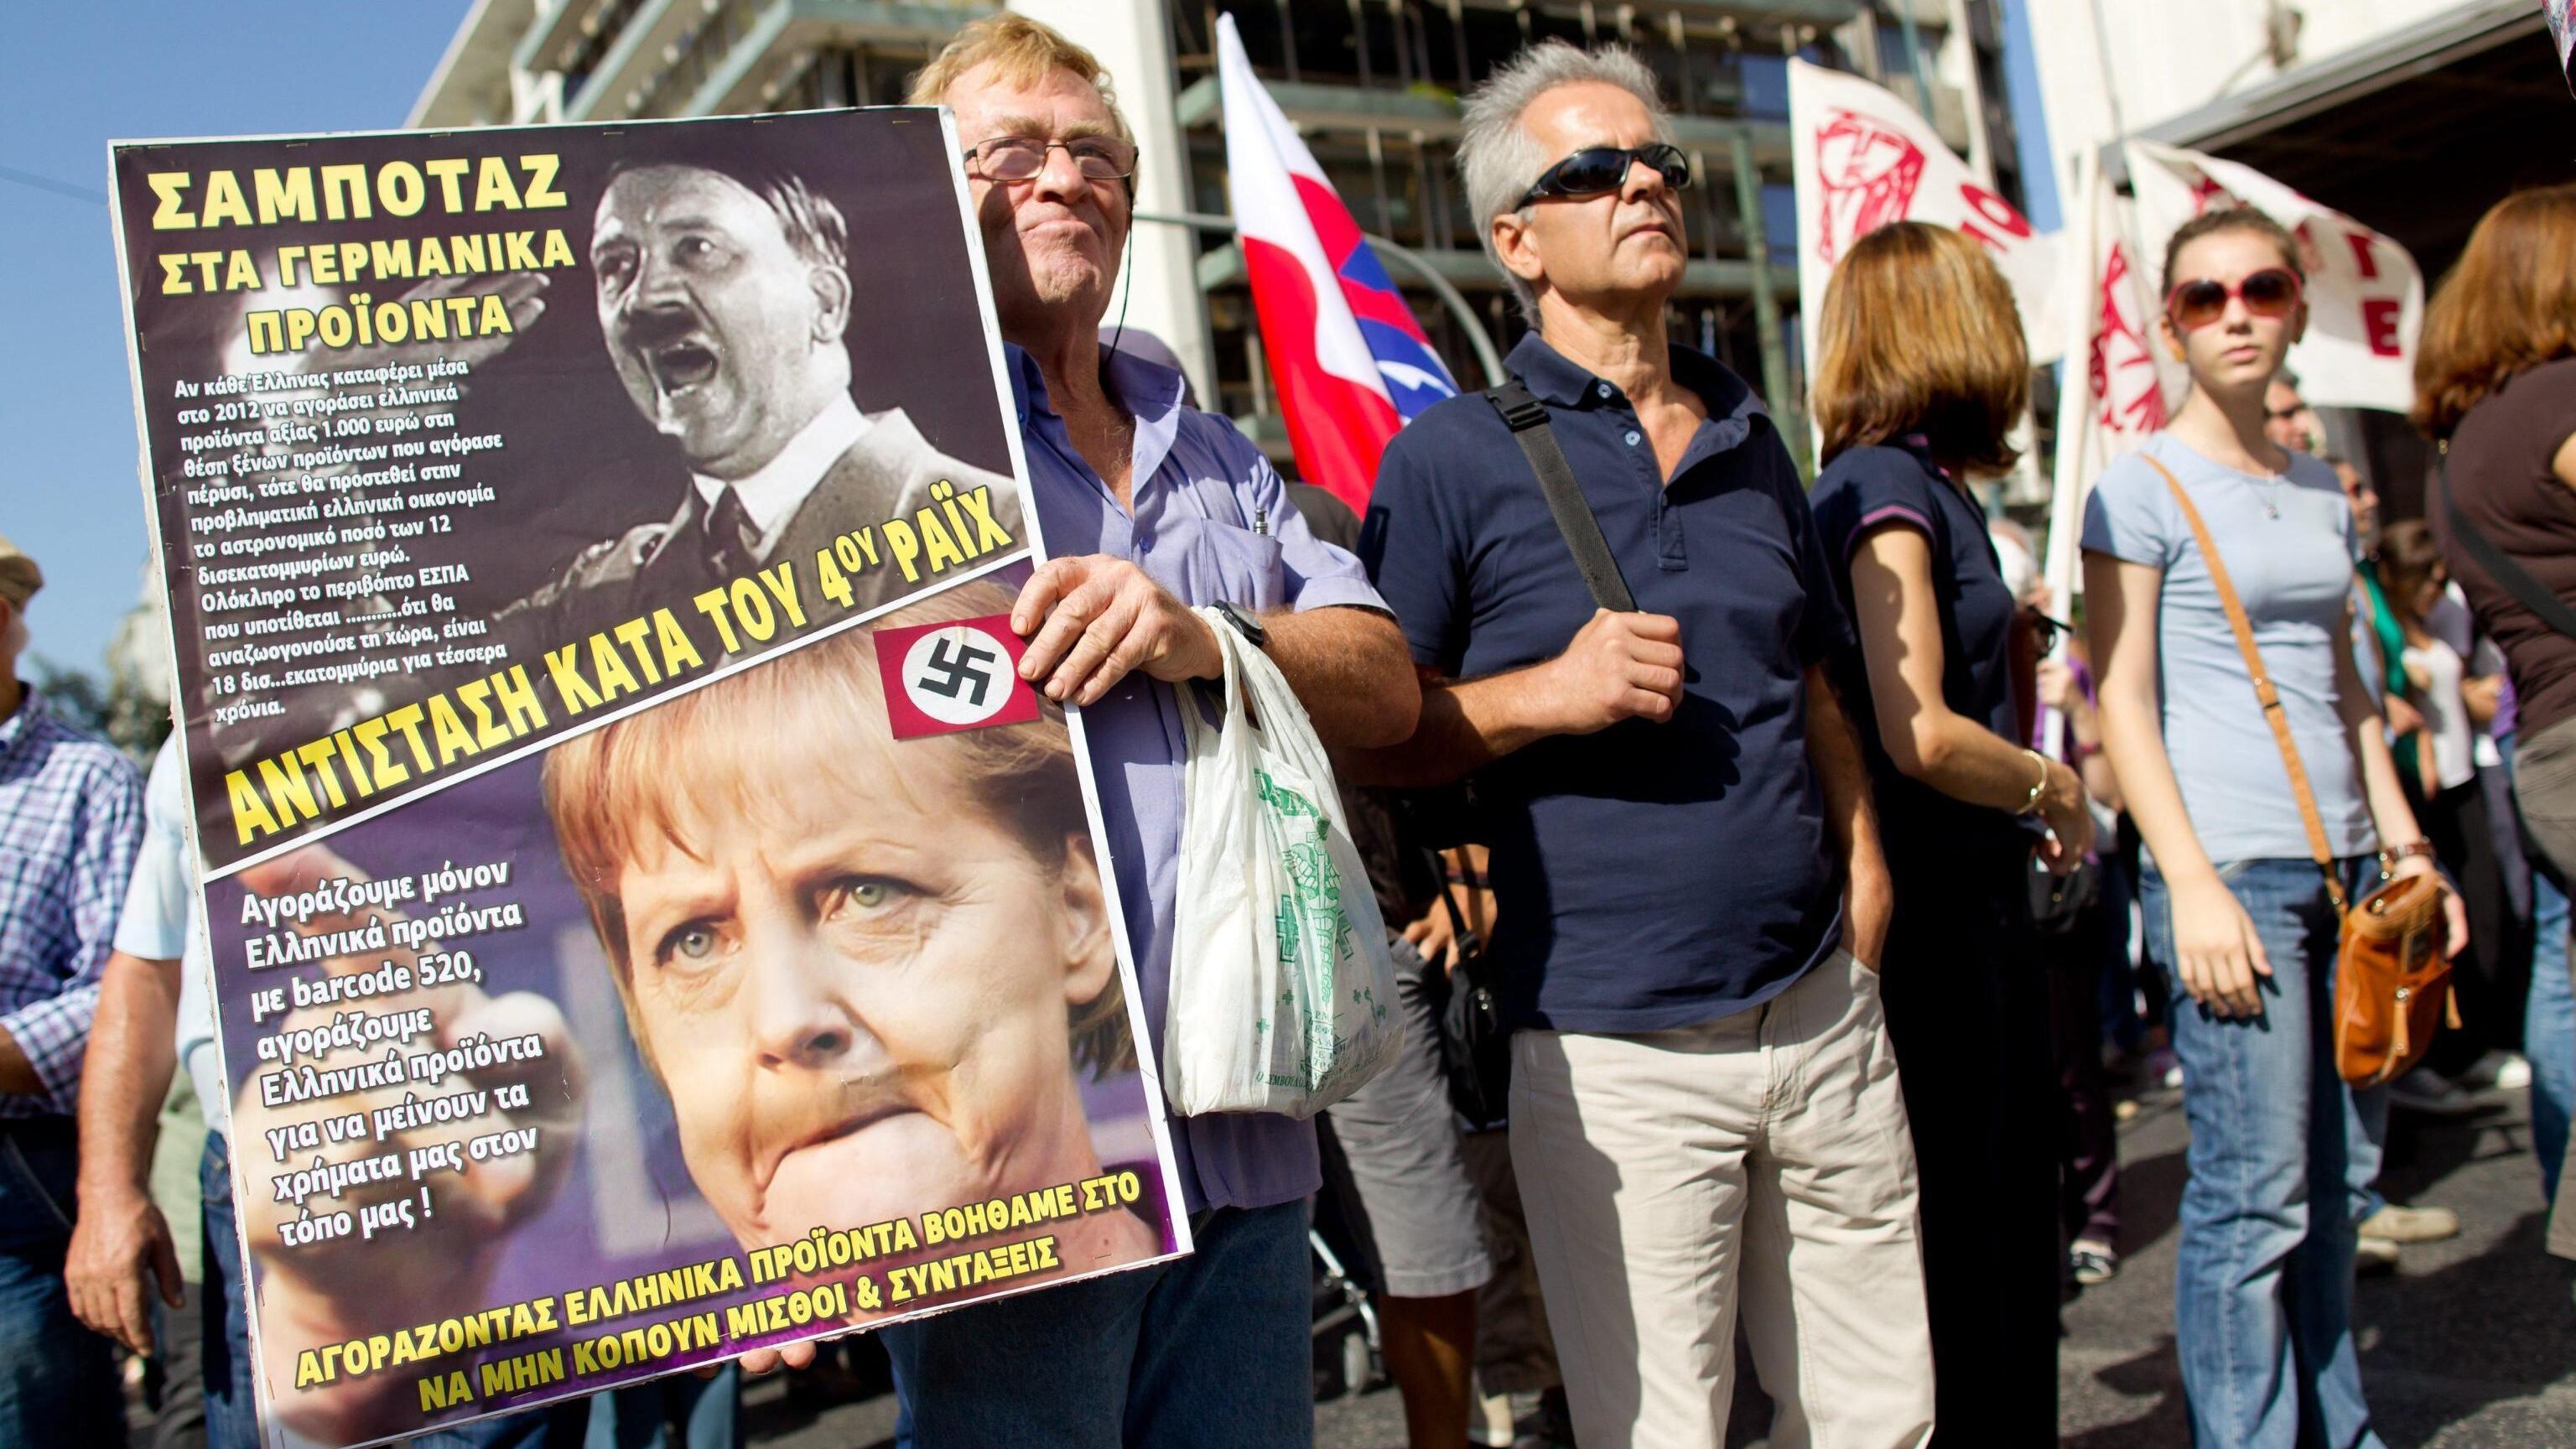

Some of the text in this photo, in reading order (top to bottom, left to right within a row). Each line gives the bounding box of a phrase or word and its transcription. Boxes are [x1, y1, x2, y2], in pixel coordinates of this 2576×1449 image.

[147, 153, 568, 231] ΣΑΜΠΟΤΑΖ
[158, 228, 575, 295] ΣΤΑ ΓΕΡΜΑΝΙΚΑ
[247, 293, 513, 354] ΠΡΟΪΟΝΤΑ
[174, 356, 469, 398] Αν κάθε Έλληνας καταφέρει μέσα
[178, 383, 458, 424] στο 2012 να αγοράσει ελληνικά
[180, 411, 454, 456] προϊόντα αξίας 1.000 ευρώ στη
[184, 432, 503, 479] θέση ξένων προϊόντων που αγόρασε
[187, 462, 461, 508] πέρυσι, τότε θα προστεθεί στην
[190, 482, 496, 537] προβληματική ελληνική οικονομία
[194, 515, 452, 558] το αστρονομικό ποσό των 12
[197, 548, 410, 585] δισεκατομμυρίων ευρώ.
[201, 564, 470, 612] Ολόκληρο το περιβόητο ΕΣΠΑ
[205, 623, 240, 640] που
[244, 610, 340, 636] υποτίθεται
[431, 594, 454, 612] θα
[208, 617, 487, 667] αναζωογονούσε τη χώρα, είναι
[212, 641, 506, 695] 18 δισ...εκατομμύρια για τέσσερα
[225, 687, 548, 846] ΑΝΤΙΣΤΑΣΗ
[545, 605, 701, 715] ΚΑΤΑ
[697, 561, 815, 653] ΤΟΥ
[880, 477, 1013, 583] ΡΑΪΧ
[215, 696, 286, 725] χρόνια.
[241, 860, 508, 927] Αγοράζουμε μόνον
[245, 901, 522, 969] Ελληνικά προϊόντα
[252, 951, 482, 1022] με barcode 520,
[257, 1008, 432, 1063] αγοράζουμε
[261, 1032, 543, 1107] Ελληνικά προϊόντα
[266, 1083, 529, 1161] για να μείνουν τα
[273, 1126, 537, 1203] χρήματα μας στον
[278, 1187, 433, 1248] τόπο μας !
[295, 1170, 1142, 1389] ΑΓΟΡΑΖΟΝΤΑΣ ΕΛΛΗΝΙΚΑ ΠΡΟΪΟΝΤΑ ΒΟΗΘΑΜΕ ΣΤΟ
[418, 1237, 1060, 1413] ΝΑ ΜΗΝ ΚΟΠΟΥΝ ΜΙΣΘΟΙ & ΣΥΝΤΑΞΕΙΣ
